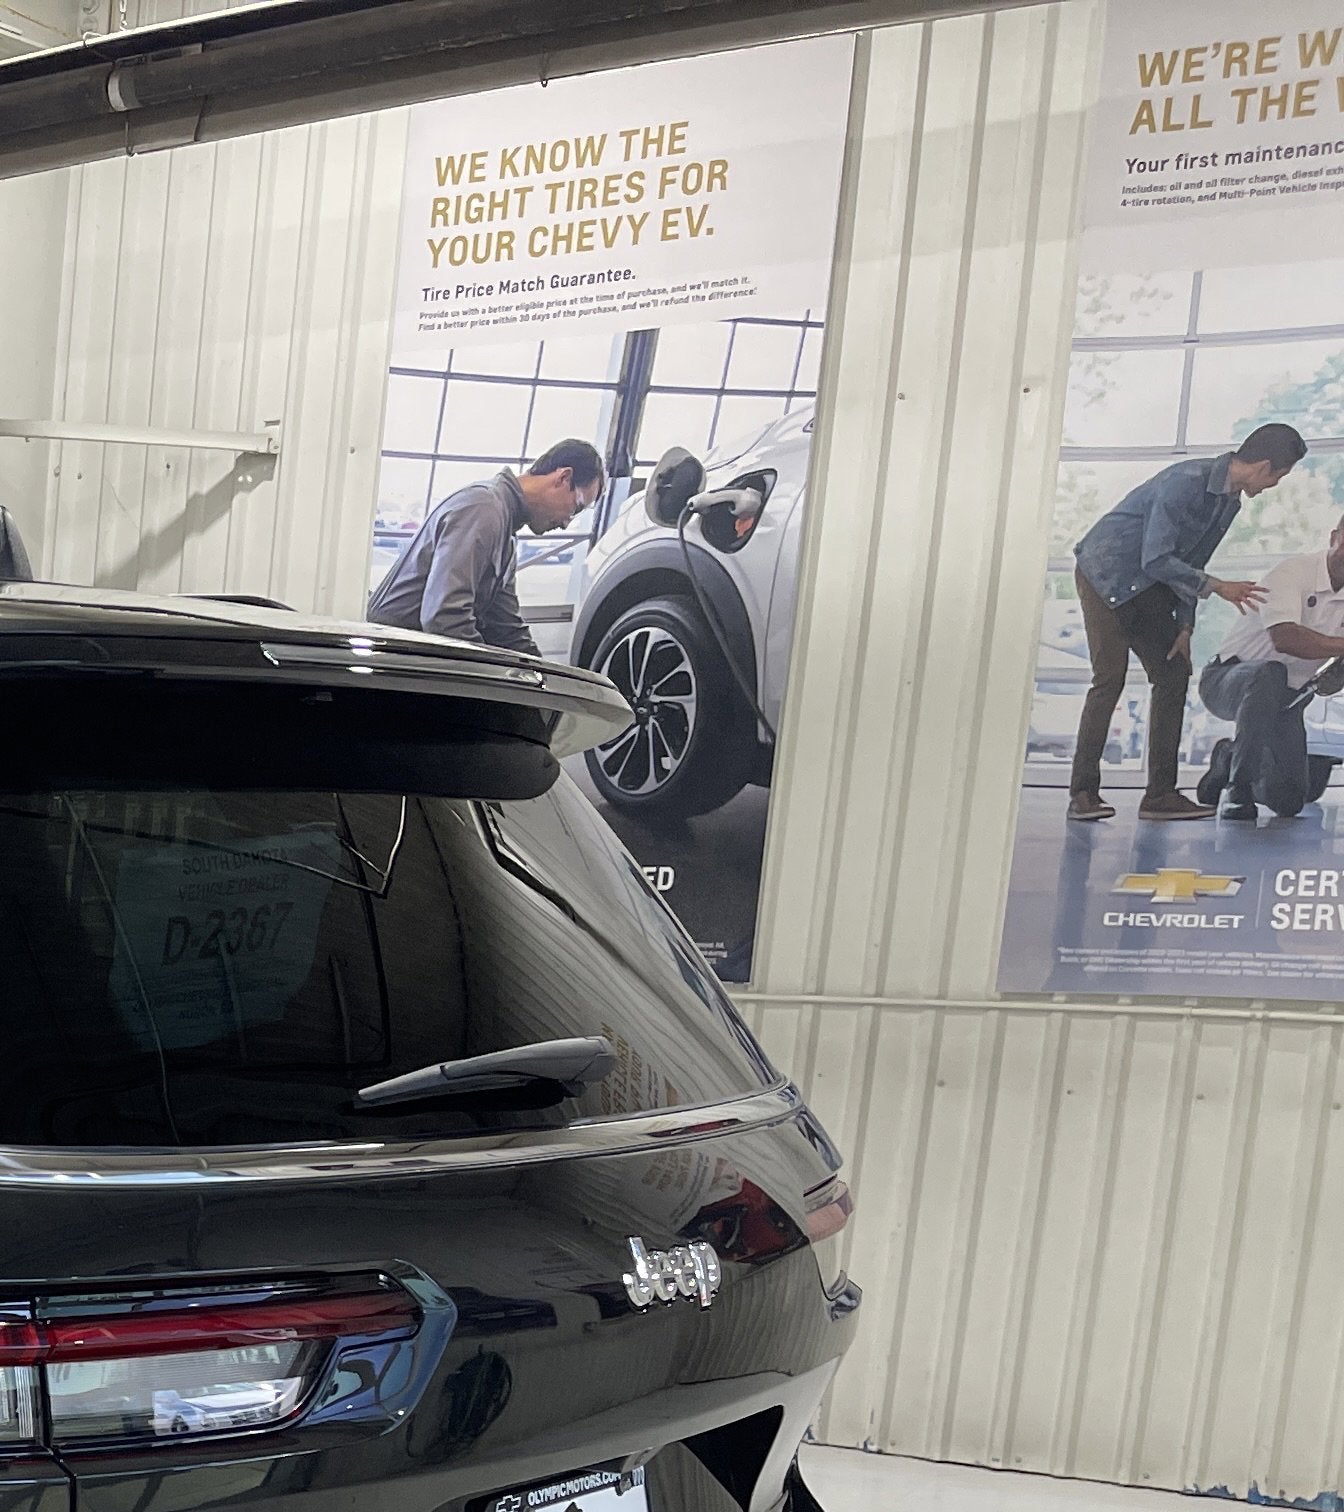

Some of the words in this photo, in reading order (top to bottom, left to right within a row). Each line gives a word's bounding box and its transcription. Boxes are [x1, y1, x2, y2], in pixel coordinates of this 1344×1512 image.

[1138, 36, 1282, 88] WE'RE
[1298, 27, 1344, 69] W
[1129, 94, 1214, 135] ALL
[1231, 79, 1320, 124] THE
[435, 150, 489, 187] WE
[499, 133, 608, 179] KNOW
[619, 121, 690, 160] THE
[1125, 158, 1169, 174] Your
[1175, 152, 1218, 170] first
[430, 186, 534, 229] RIGHT
[545, 172, 645, 214] TIRES
[658, 159, 729, 201] FOR
[1184, 180, 1204, 190] and
[1197, 192, 1217, 202] and
[427, 230, 514, 269] YOUR
[528, 212, 650, 259] CHEVY
[660, 204, 715, 242] EV.
[422, 286, 450, 302] Tire
[455, 282, 494, 299] Price
[498, 275, 545, 295] Match
[550, 268, 636, 289] Guarantee.
[443, 320, 468, 330] better
[488, 305, 514, 314] better
[1274, 869, 1344, 897] CER
[1102, 911, 1244, 930] CHEVROLET
[622, 1236, 722, 1308] Jeep
